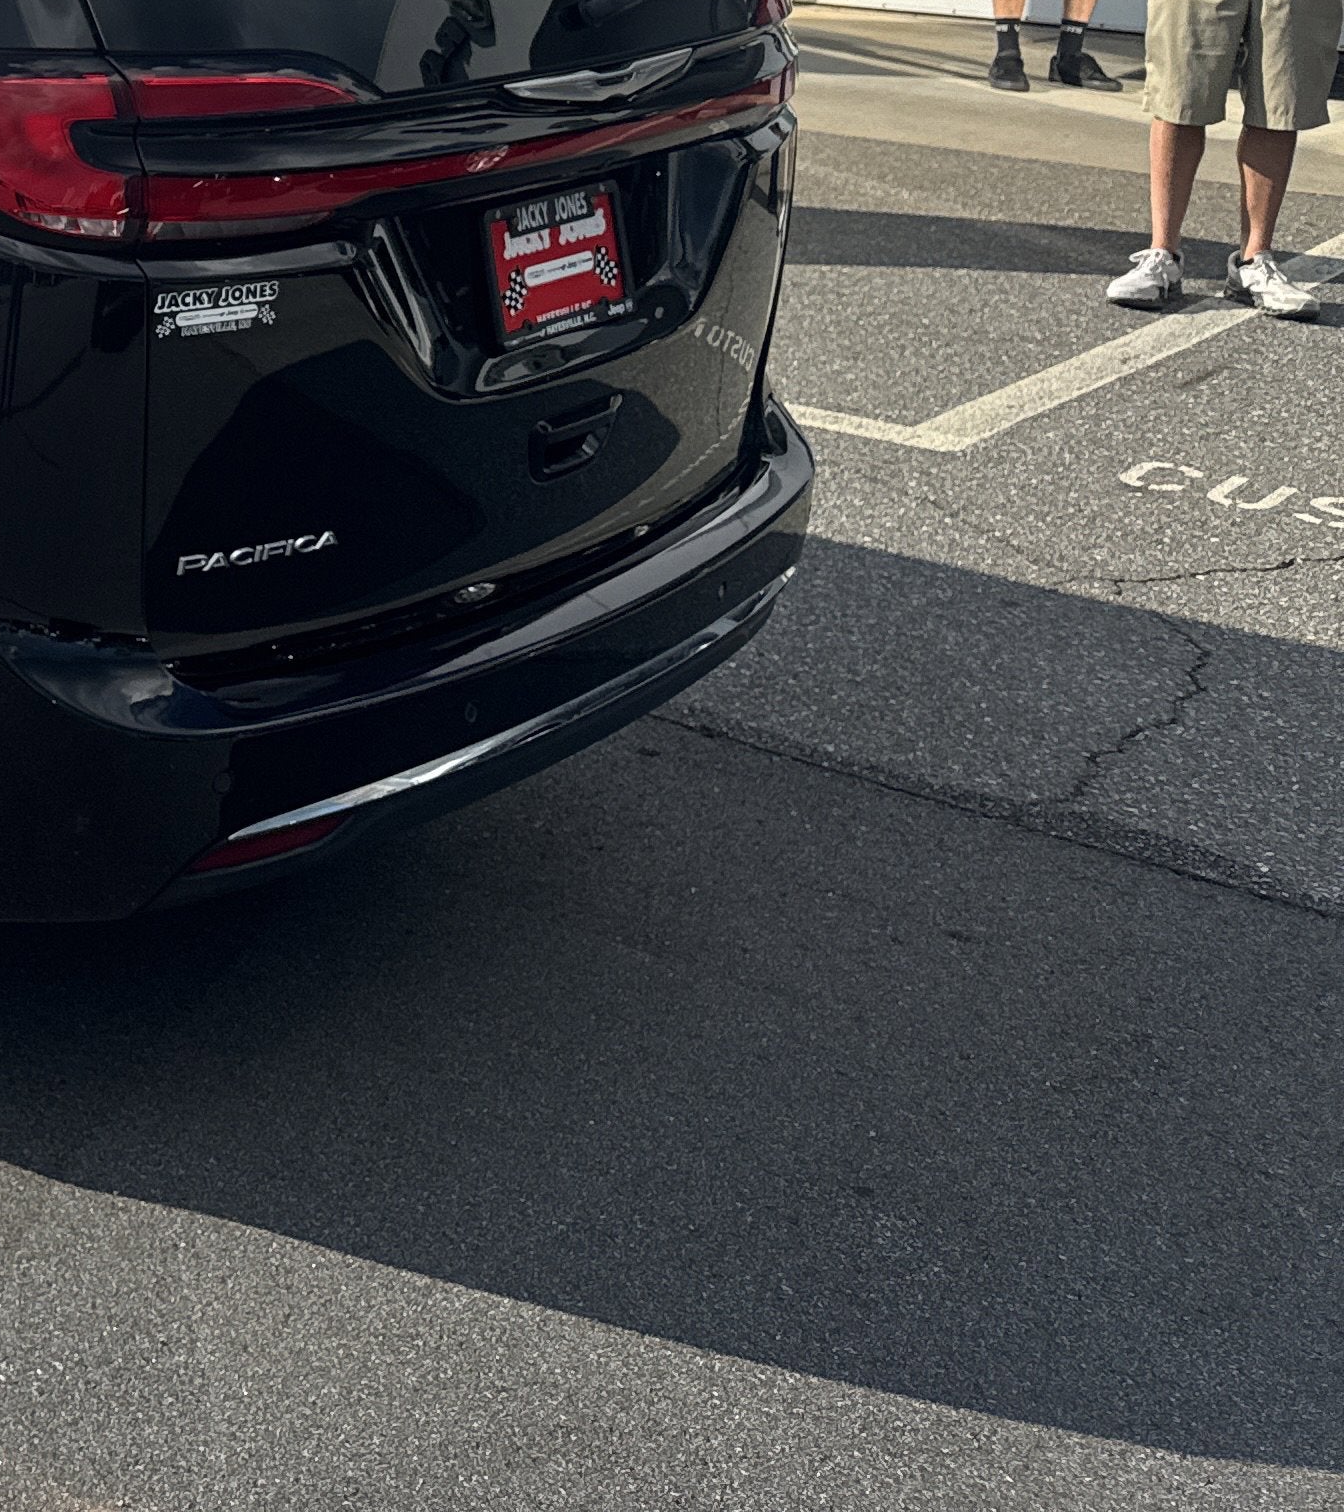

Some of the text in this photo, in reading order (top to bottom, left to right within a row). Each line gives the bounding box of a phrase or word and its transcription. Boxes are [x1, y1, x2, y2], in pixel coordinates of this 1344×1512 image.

[516, 191, 588, 231] JACKY JONES
[154, 281, 279, 313] JACKY JONES
[176, 531, 338, 576] PACIFICA
